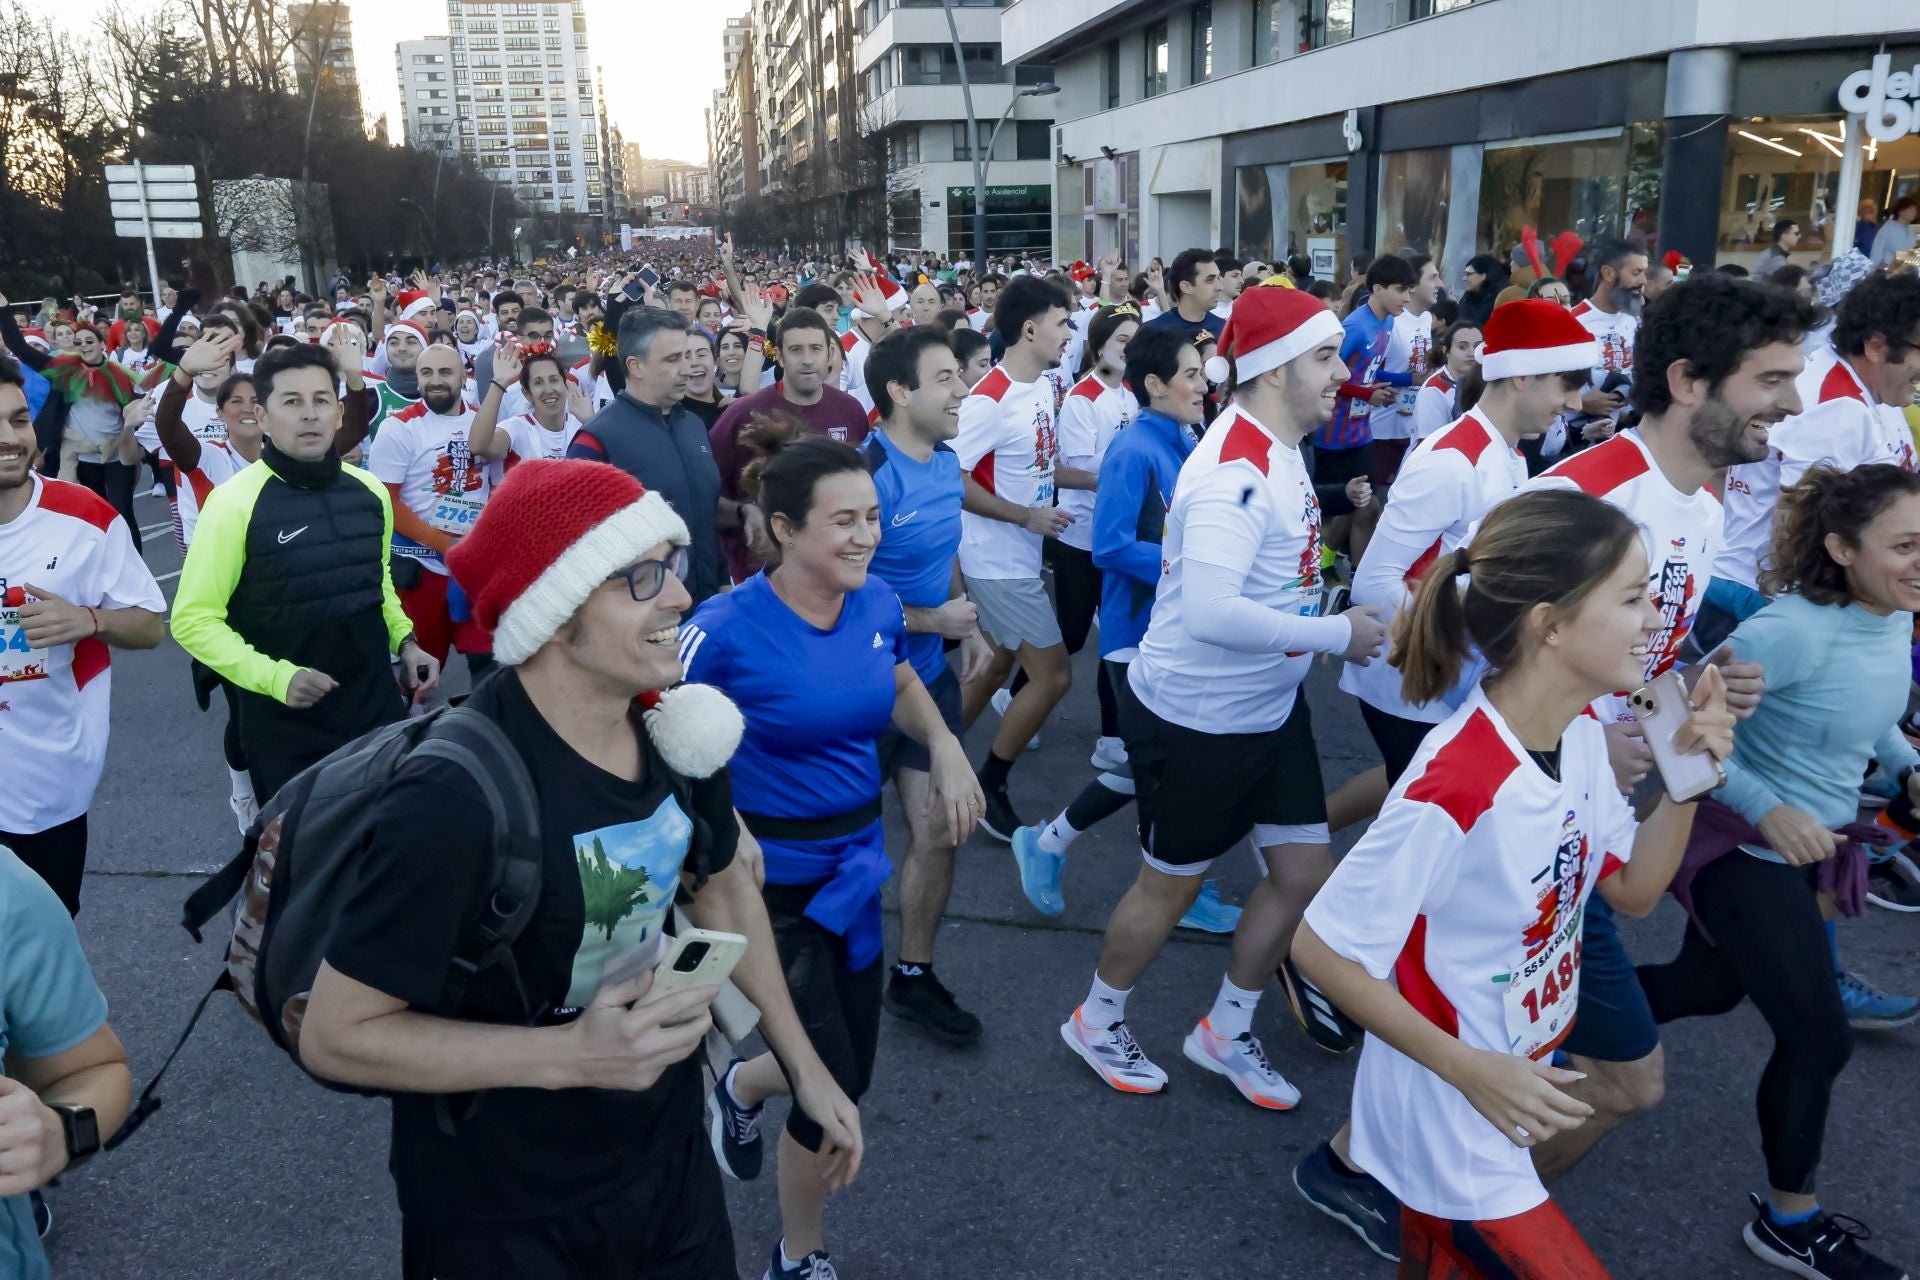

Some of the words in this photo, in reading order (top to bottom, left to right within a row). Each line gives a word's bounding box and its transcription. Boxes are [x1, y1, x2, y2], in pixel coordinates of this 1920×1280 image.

[966, 188, 990, 196] Ceo
[992, 186, 1027, 195] Asistencial
[453, 459, 468, 470] SIL
[1672, 565, 1687, 586] 55
[1664, 583, 1685, 605] SAN
[1524, 961, 1538, 978] 55
[1538, 944, 1555, 968] SAN
